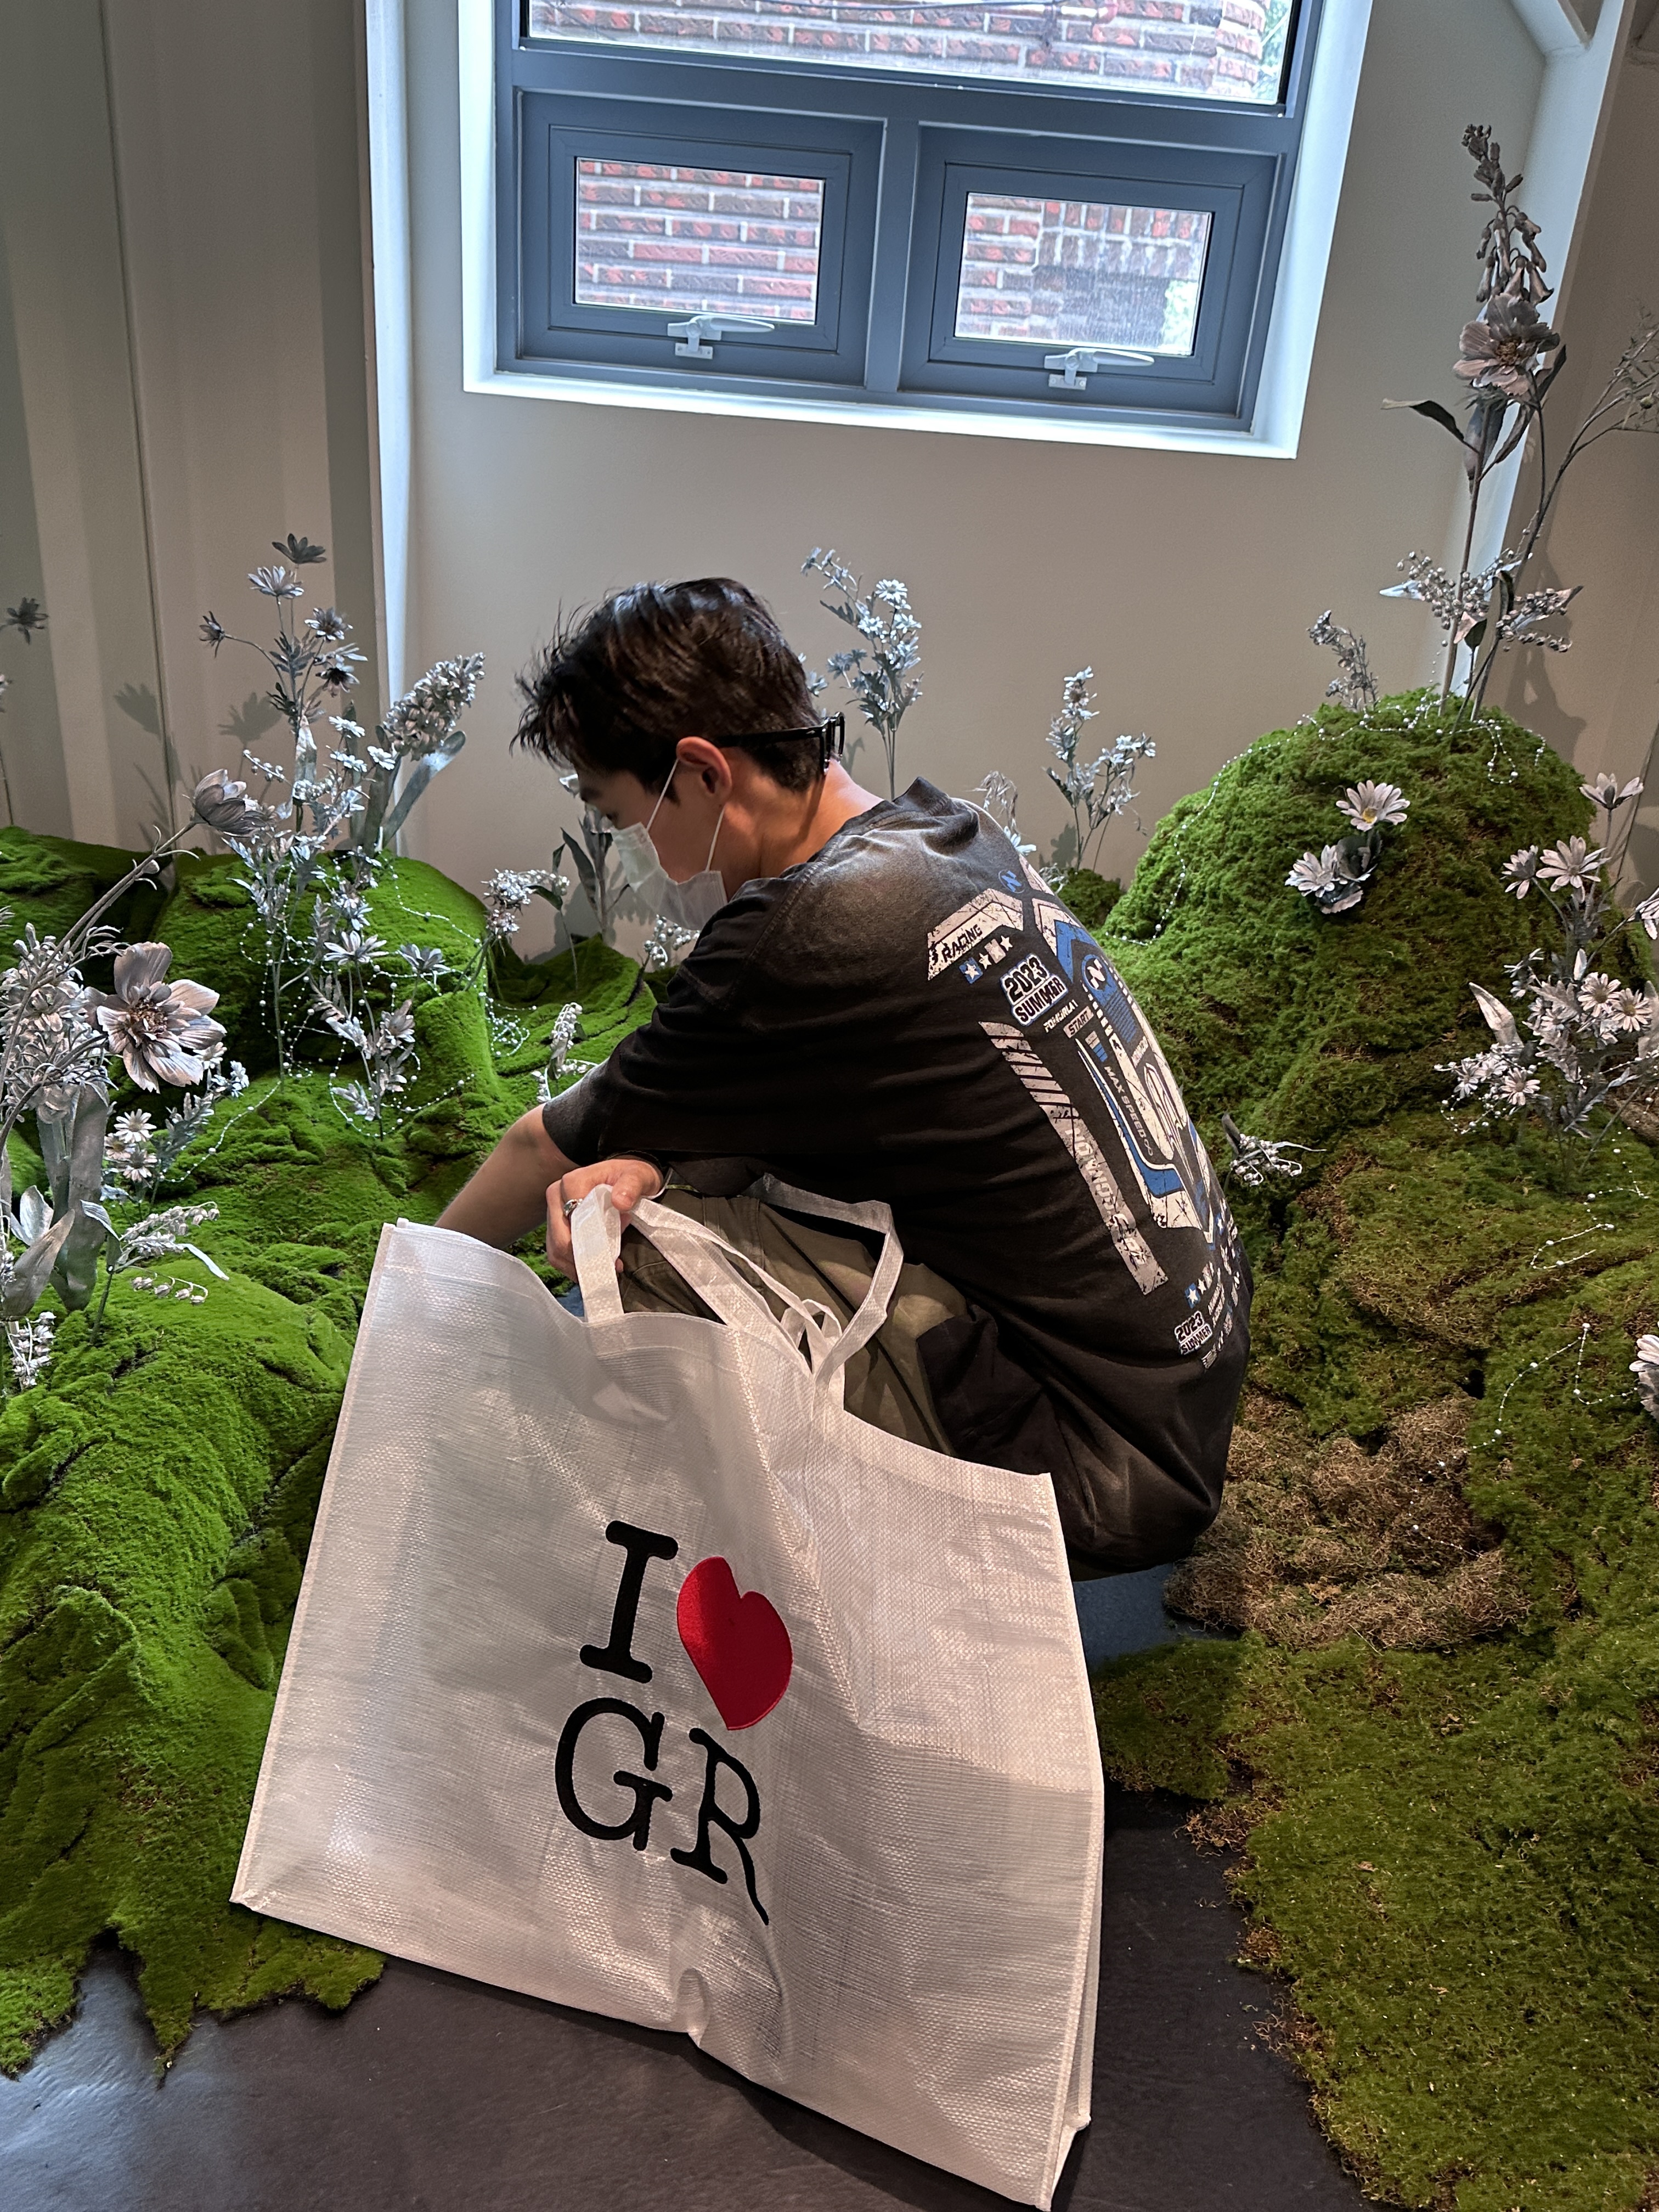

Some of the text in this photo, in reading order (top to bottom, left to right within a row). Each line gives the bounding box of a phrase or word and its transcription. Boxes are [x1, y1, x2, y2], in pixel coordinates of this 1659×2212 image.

[1005, 957, 1047, 1003] 2023
[1015, 977, 1065, 1022] SUMMER
[1068, 1010, 1090, 1035] START
[1104, 1066, 1125, 1093] MAX
[1176, 1313, 1203, 1341] 2023
[1181, 1326, 1211, 1354] SUMMER
[580, 1520, 679, 1684] I
[555, 1697, 769, 1926] GR
